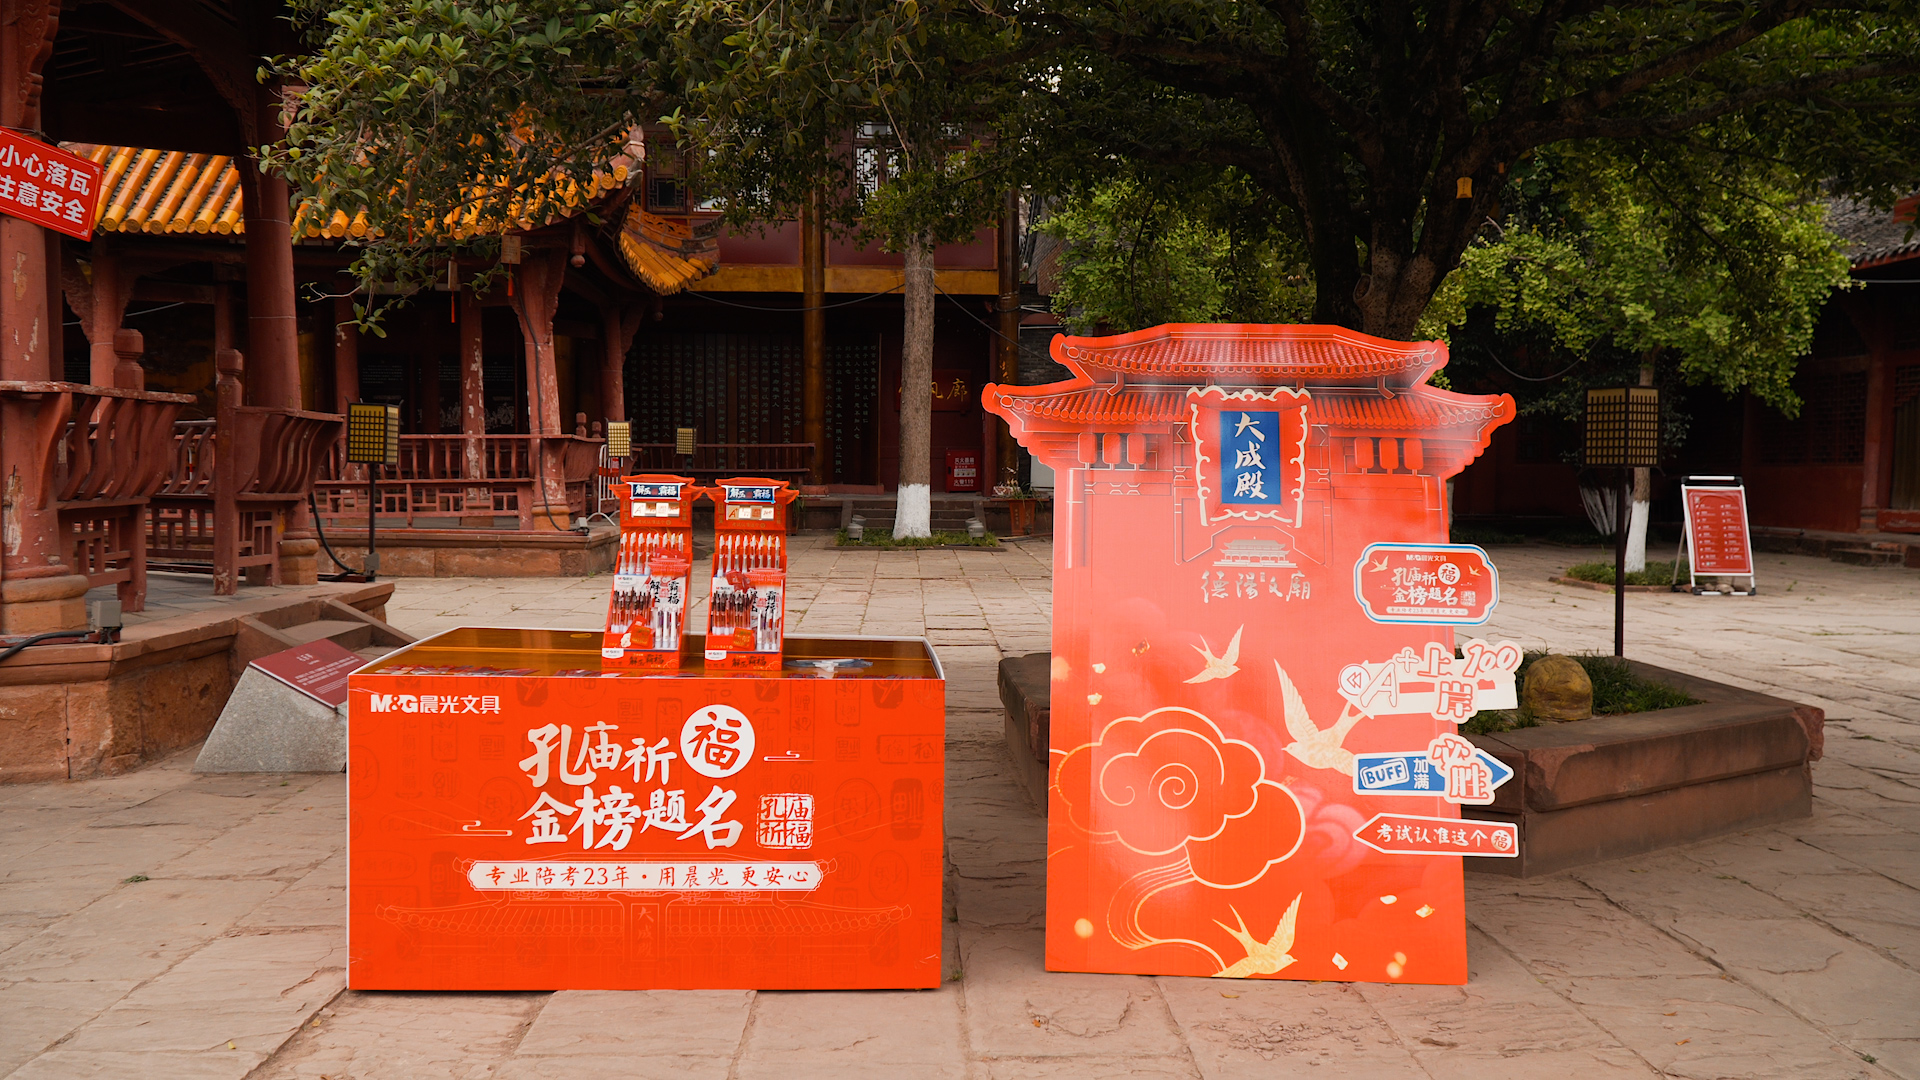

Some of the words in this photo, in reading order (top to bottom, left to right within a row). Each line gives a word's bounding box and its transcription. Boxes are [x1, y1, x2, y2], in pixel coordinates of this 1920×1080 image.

[0, 144, 91, 196] 小心落瓦
[0, 175, 86, 224] 注意安全
[1234, 412, 1268, 500] 大成殿
[1391, 564, 1457, 586] 孔庙祈福
[1392, 586, 1458, 606] 金榜题名
[1462, 644, 1518, 678] 100
[1360, 650, 1419, 708] A+
[1417, 647, 1473, 718] 上岸
[370, 694, 501, 714] M&G晨光文具
[518, 709, 748, 788] 孔庙祈福
[1367, 764, 1402, 784] BUFF
[1414, 758, 1430, 790] 加满
[1431, 738, 1490, 799] 必胜
[517, 785, 744, 851] 金榜题名
[763, 796, 808, 820] 孔庙
[760, 822, 812, 846] 祈福
[1376, 823, 1508, 849] 考试认准这个福
